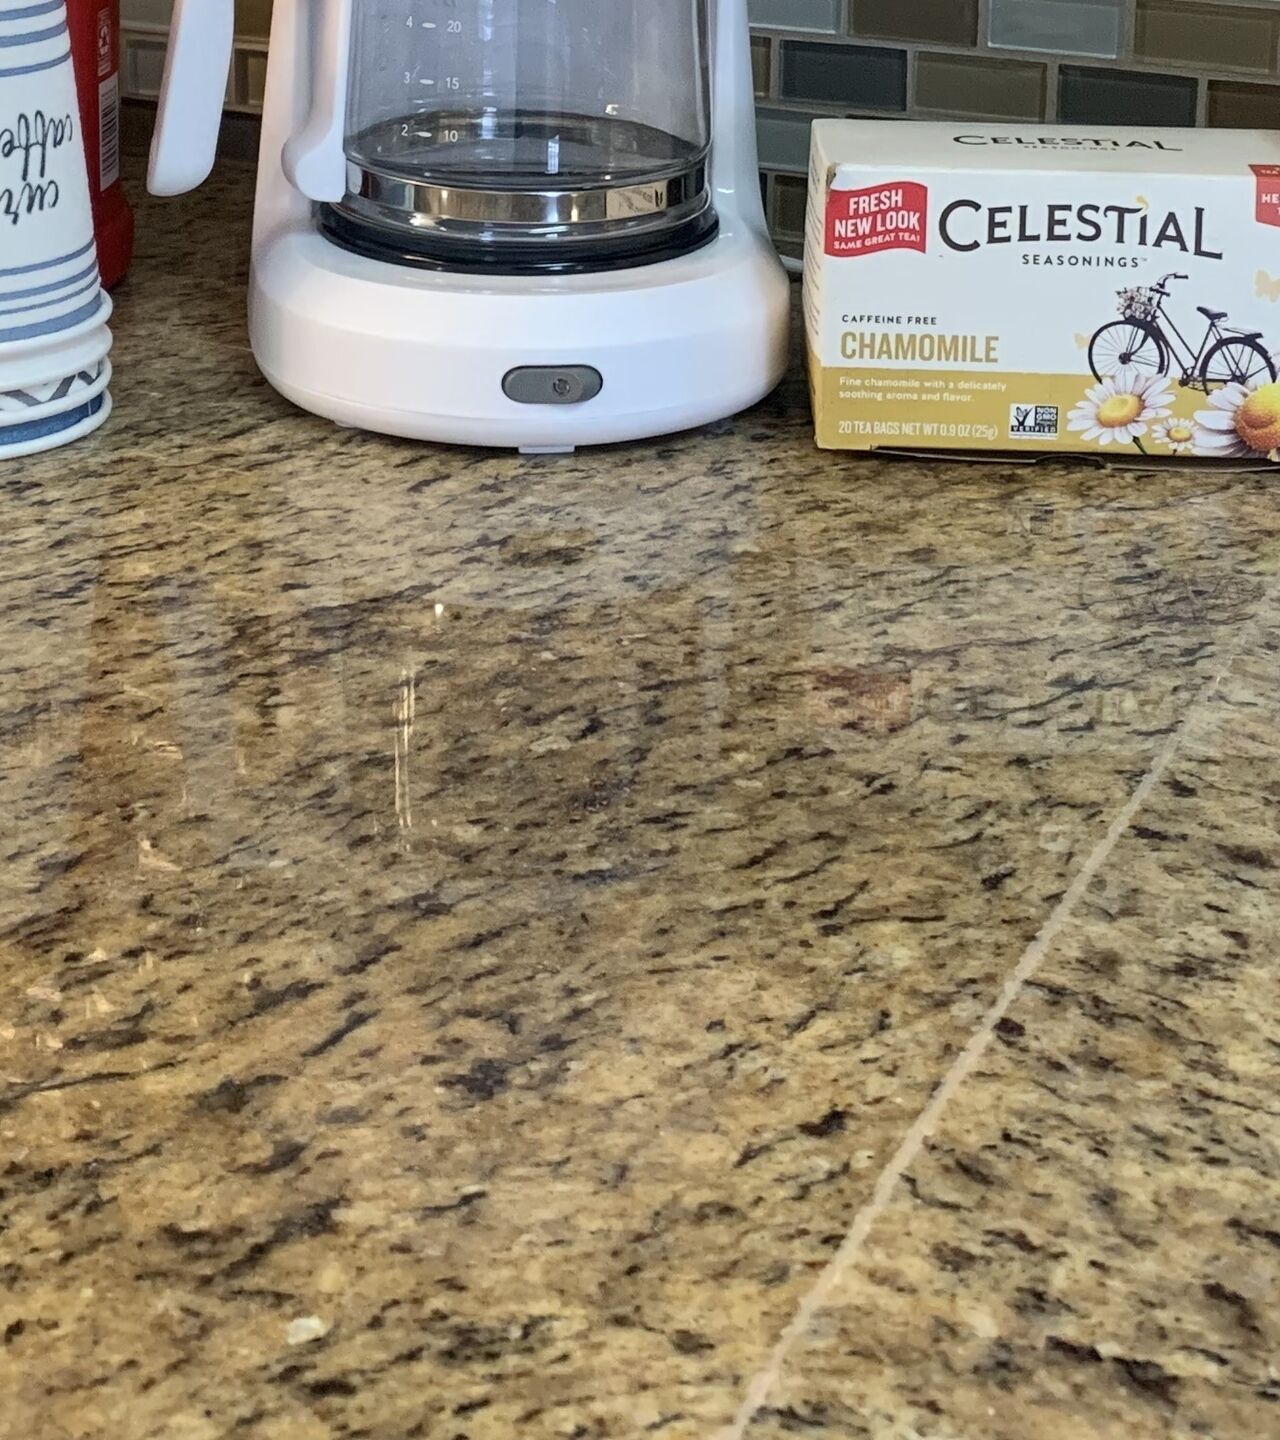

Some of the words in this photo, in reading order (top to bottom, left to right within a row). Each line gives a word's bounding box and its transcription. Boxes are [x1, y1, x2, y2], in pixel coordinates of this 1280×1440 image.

[406, 16, 413, 28] 4
[447, 20, 462, 33] 20
[403, 71, 411, 84] 3
[445, 77, 460, 90] 15
[401, 124, 409, 137] 2
[443, 130, 458, 142] 10
[953, 135, 1183, 152] CELESTIAL
[848, 189, 903, 216] FRESH
[834, 216, 873, 238] NEW
[876, 210, 921, 232] LOOK
[938, 197, 1223, 260] CELESTIAL
[833, 240, 862, 250] SAME
[864, 233, 896, 246] GREAT
[898, 232, 921, 242] TEA!
[1022, 254, 1140, 268] SEASONINGS
[842, 314, 902, 324] CAFFEINE
[907, 316, 937, 325] FREE
[840, 331, 999, 363] CHAMOMILE
[839, 377, 861, 386] Fine
[864, 378, 920, 388] chamomile
[924, 380, 945, 389] with
[957, 380, 1007, 392] delicately
[839, 390, 882, 401] soothing
[921, 392, 939, 401] and
[943, 392, 975, 402] flavor.
[838, 421, 851, 434] 20
[854, 421, 870, 434] TEA
[873, 422, 900, 435] BAGS
[901, 422, 920, 436] NET
[922, 423, 939, 436] WT
[940, 424, 956, 437] 0.9
[958, 425, 970, 438] OZ
[972, 425, 998, 440] (25g)
